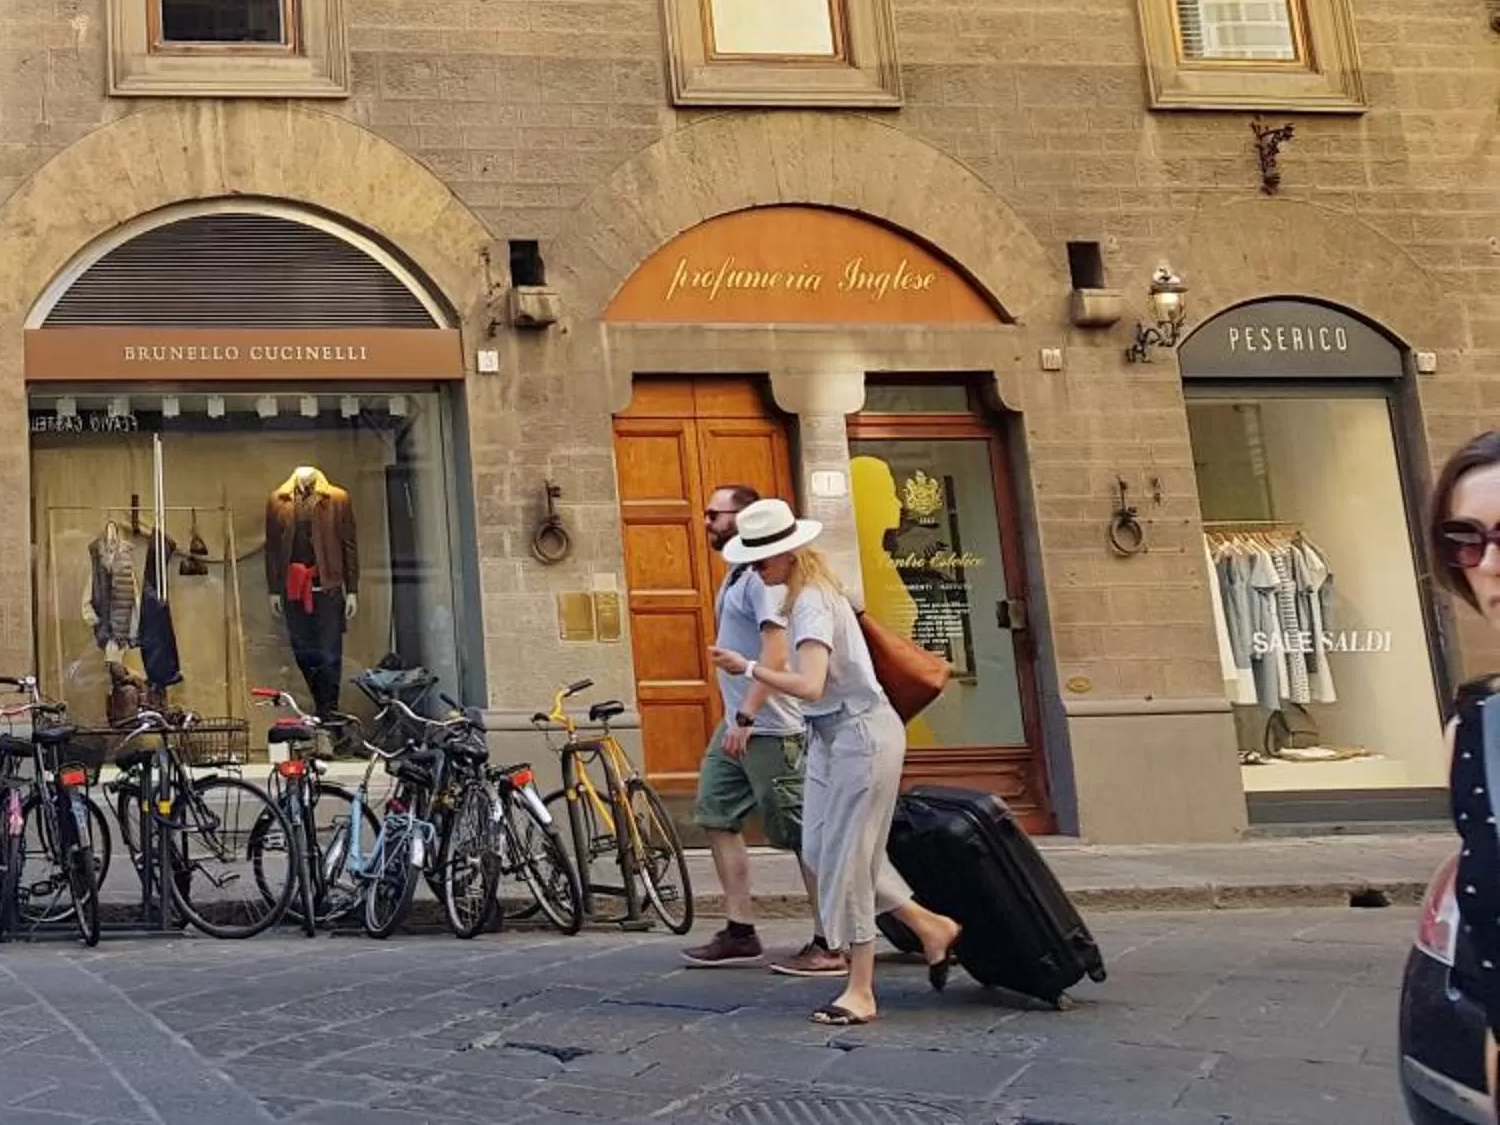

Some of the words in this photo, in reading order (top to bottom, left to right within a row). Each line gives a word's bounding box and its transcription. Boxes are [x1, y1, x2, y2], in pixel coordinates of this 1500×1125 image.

[837, 255, 936, 300] Inglese
[1229, 326, 1347, 352] PESERICO
[124, 346, 239, 360] BRUNELLO
[250, 346, 367, 360] CUCINELLI
[1253, 631, 1314, 653] SALE
[1321, 630, 1393, 653] SALDI
